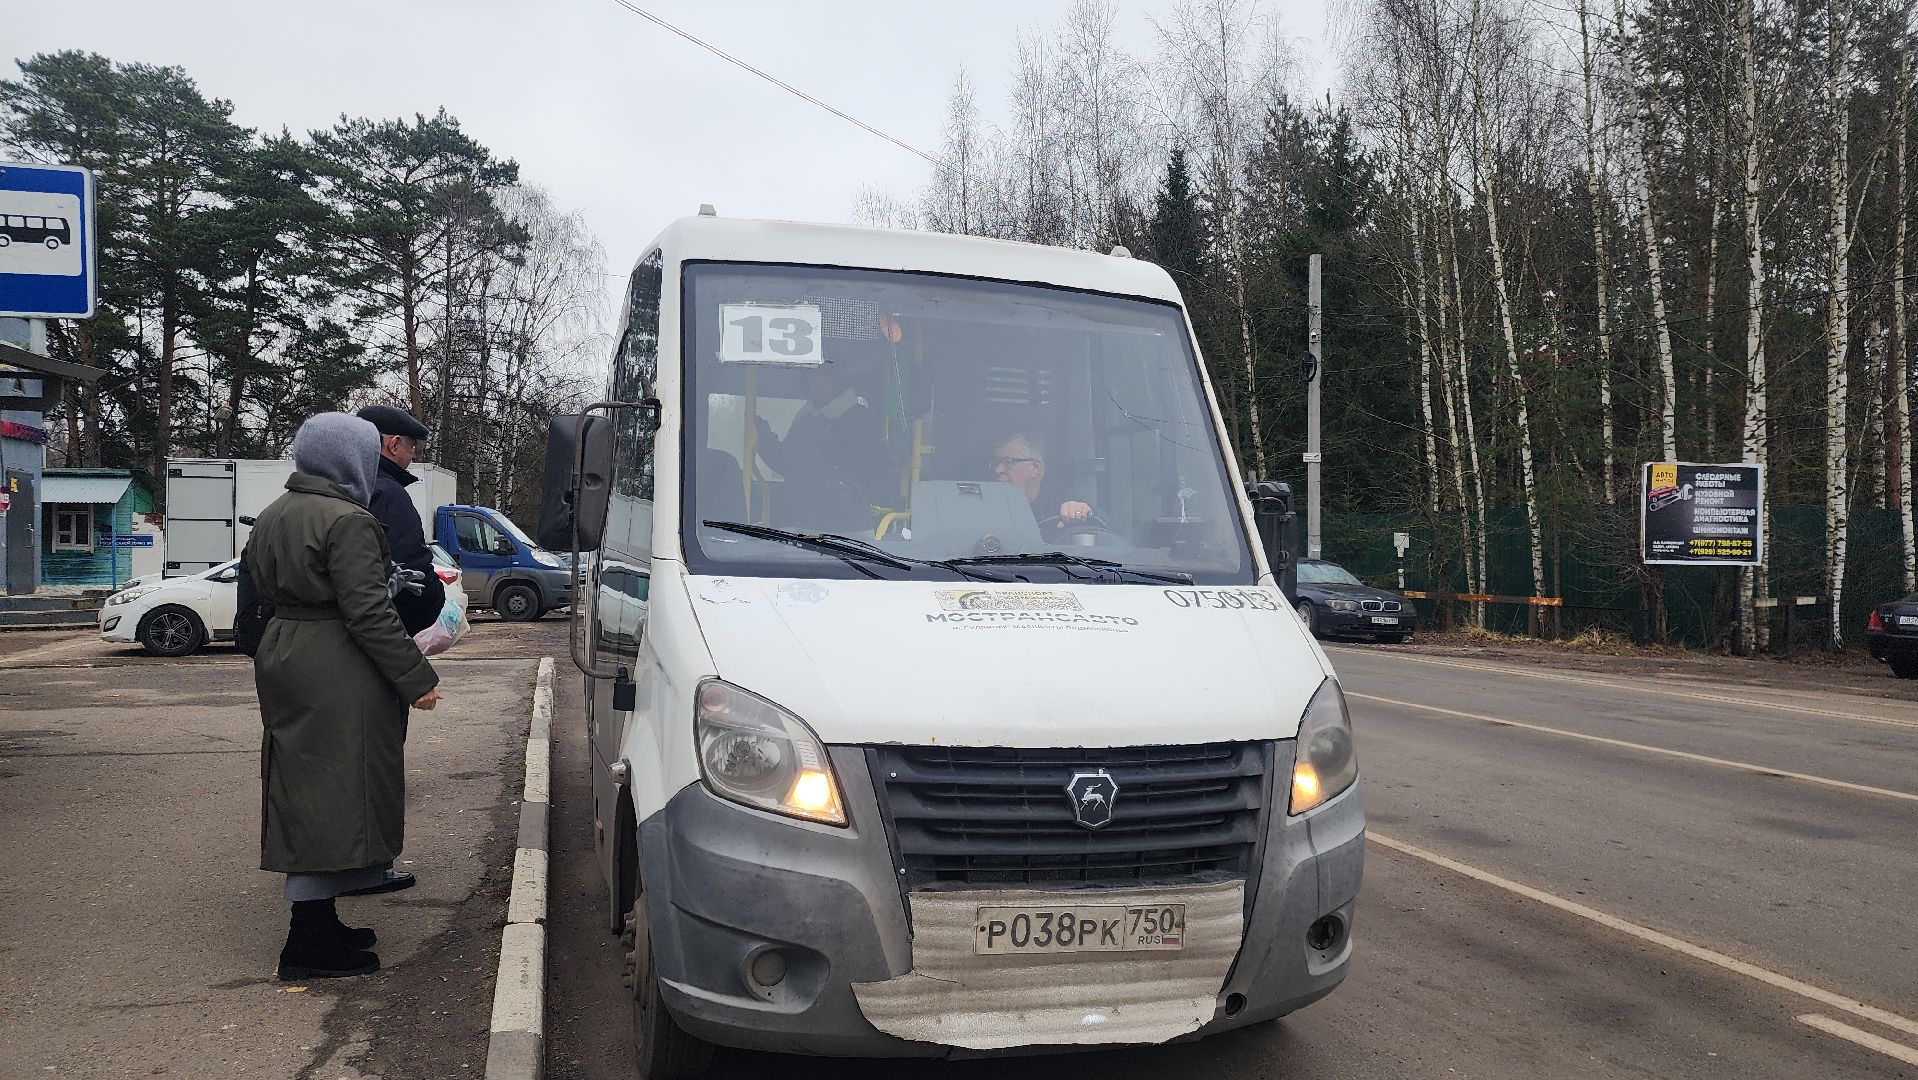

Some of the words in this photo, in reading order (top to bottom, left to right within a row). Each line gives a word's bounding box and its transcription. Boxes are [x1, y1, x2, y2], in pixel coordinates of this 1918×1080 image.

[729, 315, 814, 356] 13
[1695, 473, 1742, 481] СЛЕСАРНЫЕ
[1695, 480, 1726, 488] РАБОТЫ
[1694, 489, 1735, 498] КУЗОВНОЙ
[1694, 497, 1725, 505] РЕМОНТ
[1694, 508, 1756, 516] КОМПЬЮТЕРНАЯ
[1693, 515, 1749, 523] ДИАГНОСТИКА
[1692, 526, 1749, 534] ШИНОМОНТАЖ
[925, 612, 1140, 626] МОСТРАНСАВТО
[1128, 908, 1176, 936] 750
[1137, 935, 1161, 945] RUS
